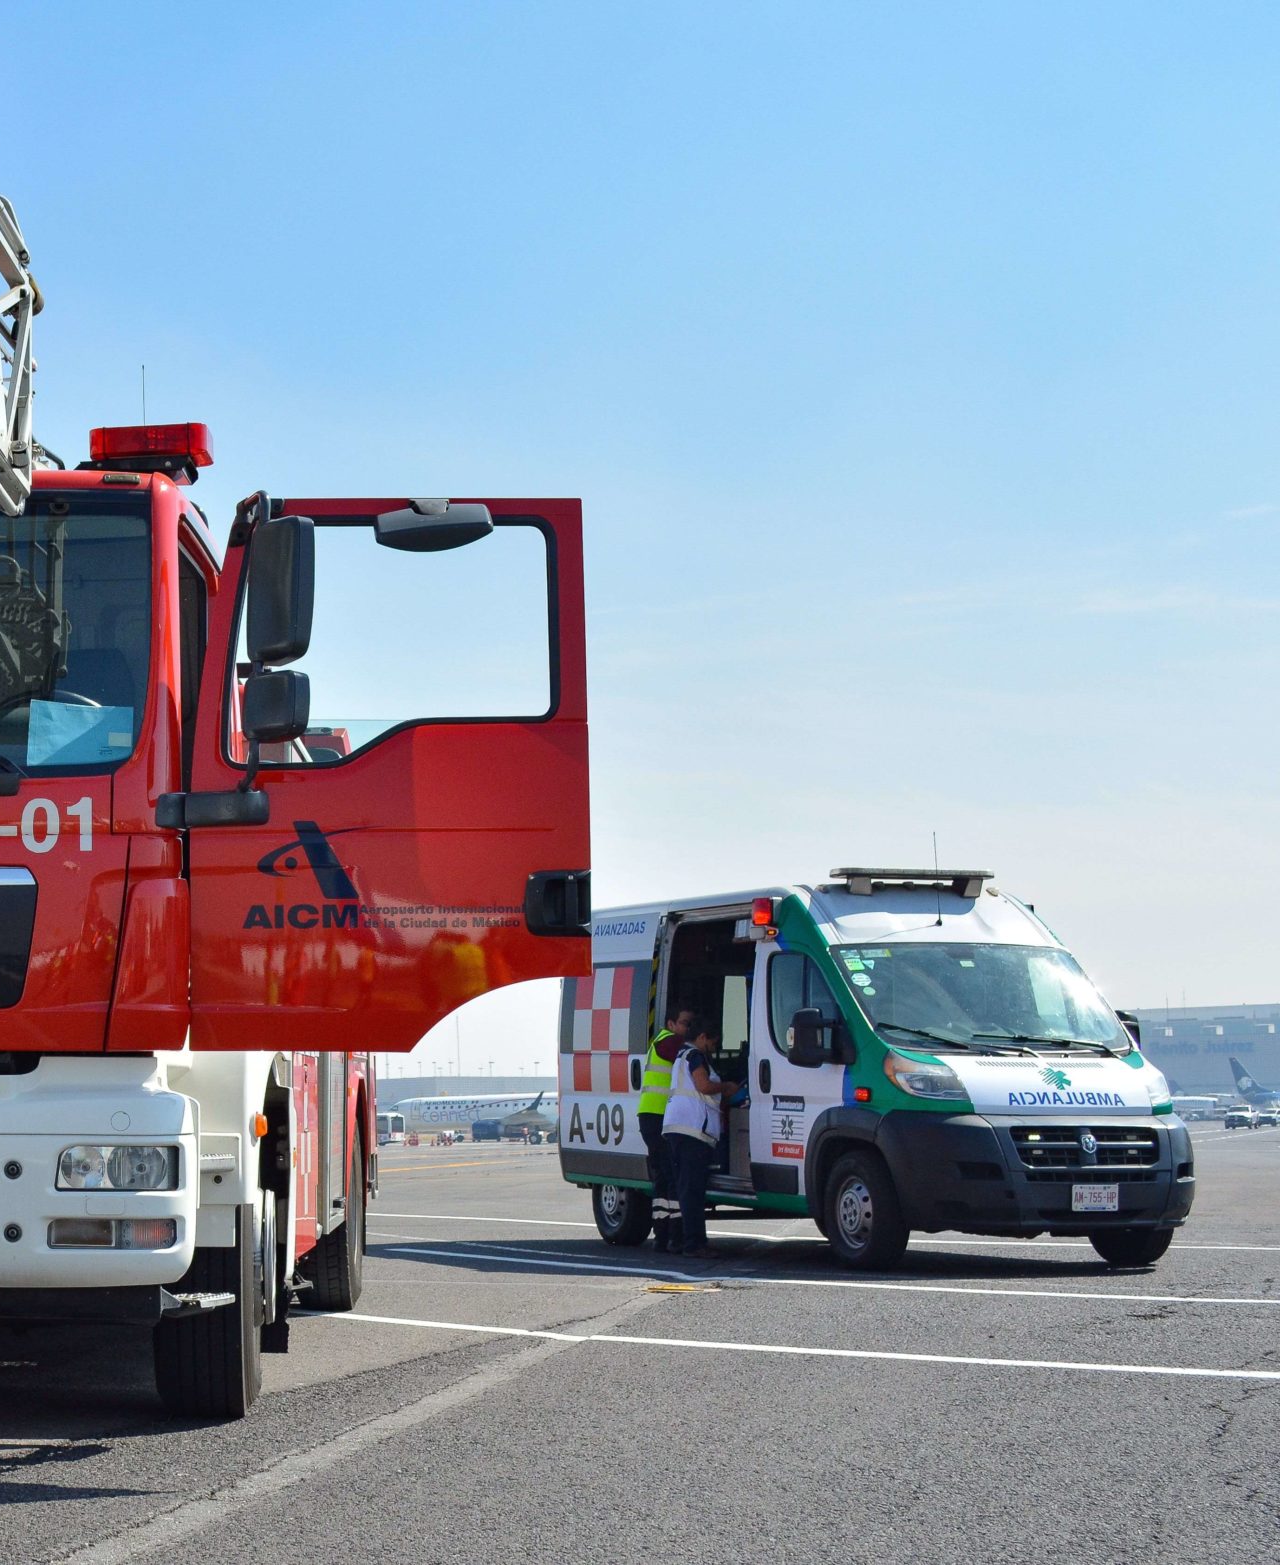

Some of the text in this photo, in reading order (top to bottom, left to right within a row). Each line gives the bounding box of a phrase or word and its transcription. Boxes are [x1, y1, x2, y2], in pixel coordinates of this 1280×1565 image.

[242, 903, 359, 929] AICM
[359, 903, 526, 916] Aeropuerto Internacional
[363, 917, 379, 929] de
[383, 917, 396, 929] la
[400, 917, 448, 929] Ciudad
[451, 917, 468, 928] de
[593, 921, 646, 937] AVANZADAS
[1149, 1041, 1199, 1055] Benito
[568, 1102, 625, 1146] A-09
